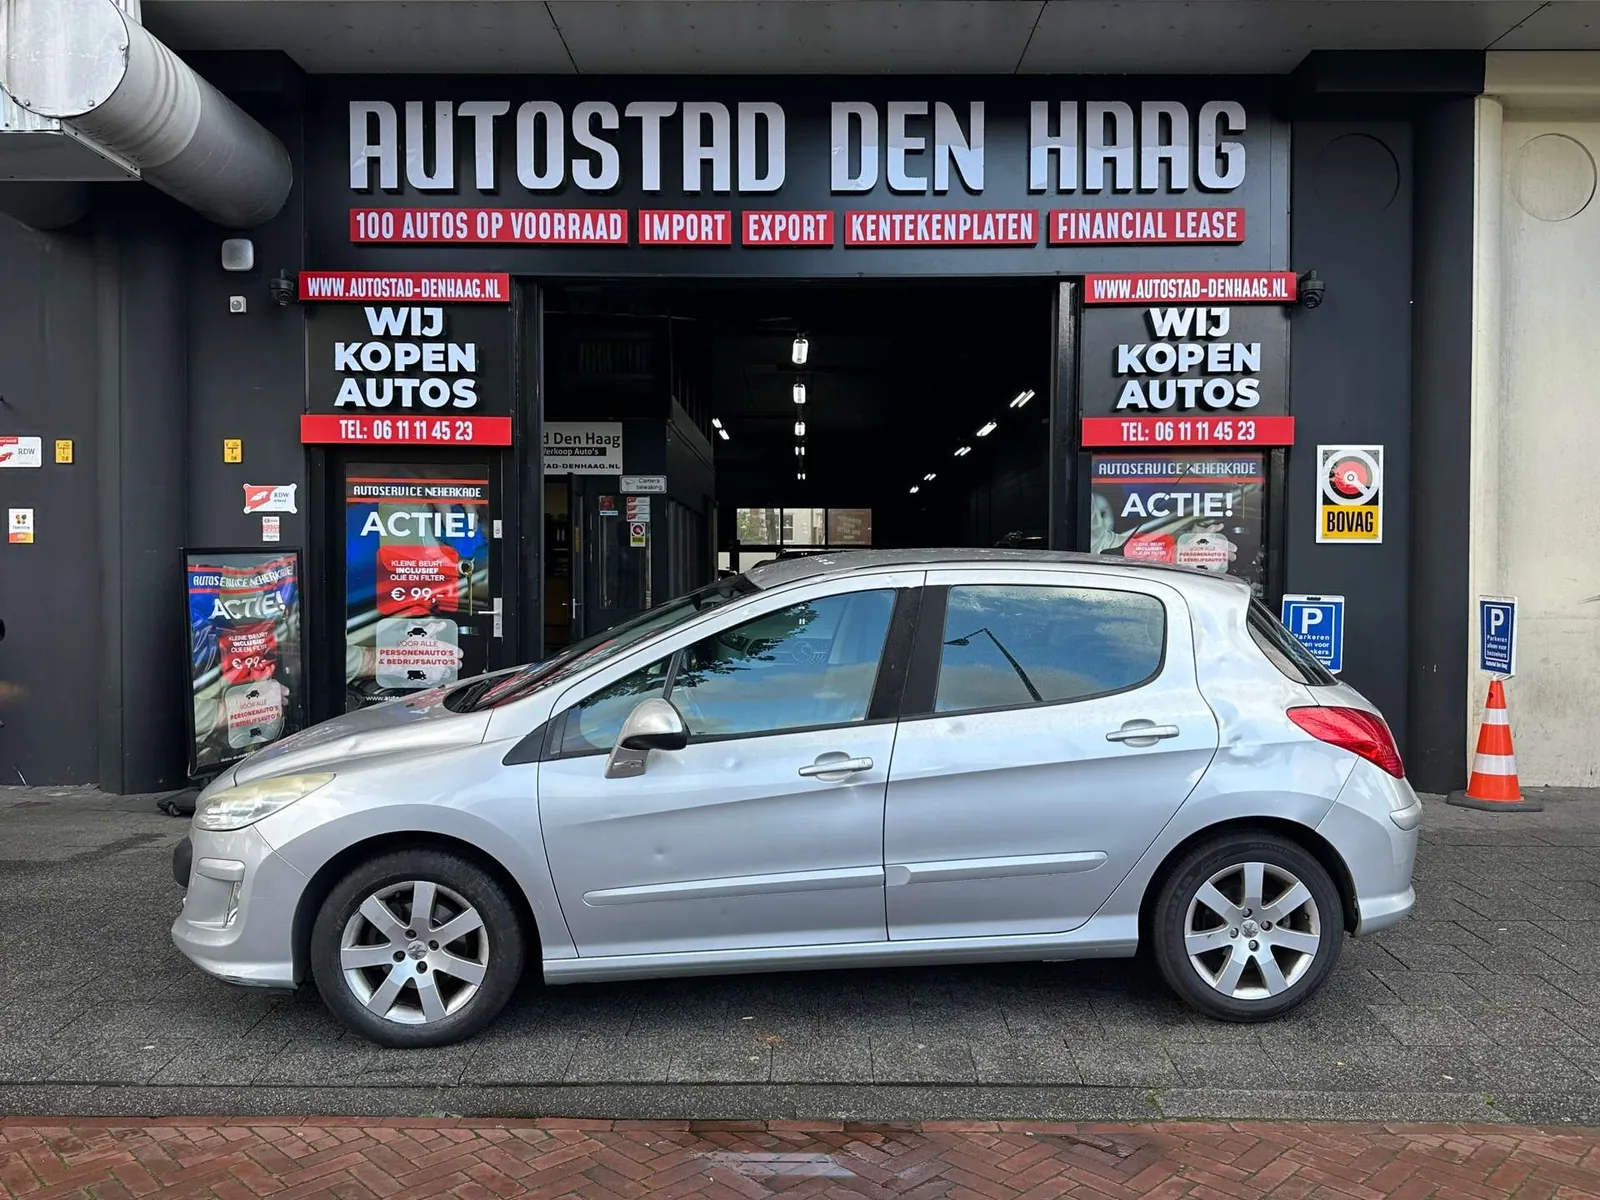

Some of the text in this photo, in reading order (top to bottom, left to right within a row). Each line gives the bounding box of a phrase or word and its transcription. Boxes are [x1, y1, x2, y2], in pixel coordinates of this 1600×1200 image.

[350, 101, 1246, 191] AUTOSTAD DEN HAAG
[356, 212, 622, 240] 100 AUTOS OP VOORRAAD
[645, 213, 725, 241] IMPORT
[749, 214, 827, 241] EXPORT
[852, 213, 1033, 241] KENTEKENPLATEN
[1058, 211, 1237, 240] FINANCIAL LEASE
[307, 277, 501, 299] WWW.AUTOSTAD-DENHAAG.NL
[1094, 278, 1288, 299] WWW.AUTOSTAD-DENHAAG.NL
[364, 307, 444, 337] WIJ
[1150, 307, 1230, 337] WIJ
[334, 342, 476, 372] KOPEN
[1118, 342, 1261, 373] KOPEN
[334, 378, 477, 408] AUTOS
[1116, 378, 1260, 409] AUTOS
[339, 420, 473, 440] TEL: 06 11 11 45 23
[554, 432, 580, 445] Den
[586, 432, 620, 448] Haag
[1121, 421, 1255, 441] TEL: 06 11 11 45 23
[1098, 462, 1256, 475] AUTOSERVICE NEHERKADE
[353, 485, 481, 497] AUTOSERVICE NEHERKADE
[1121, 492, 1233, 517] ACTIE!
[360, 511, 475, 538] ACTIE!
[1327, 511, 1373, 532] BOVAG
[208, 591, 286, 619] ACTIE!
[391, 587, 444, 603] € 99,-
[1301, 608, 1323, 634] P
[1491, 608, 1504, 635] P
[1487, 635, 1507, 643] Parkeren
